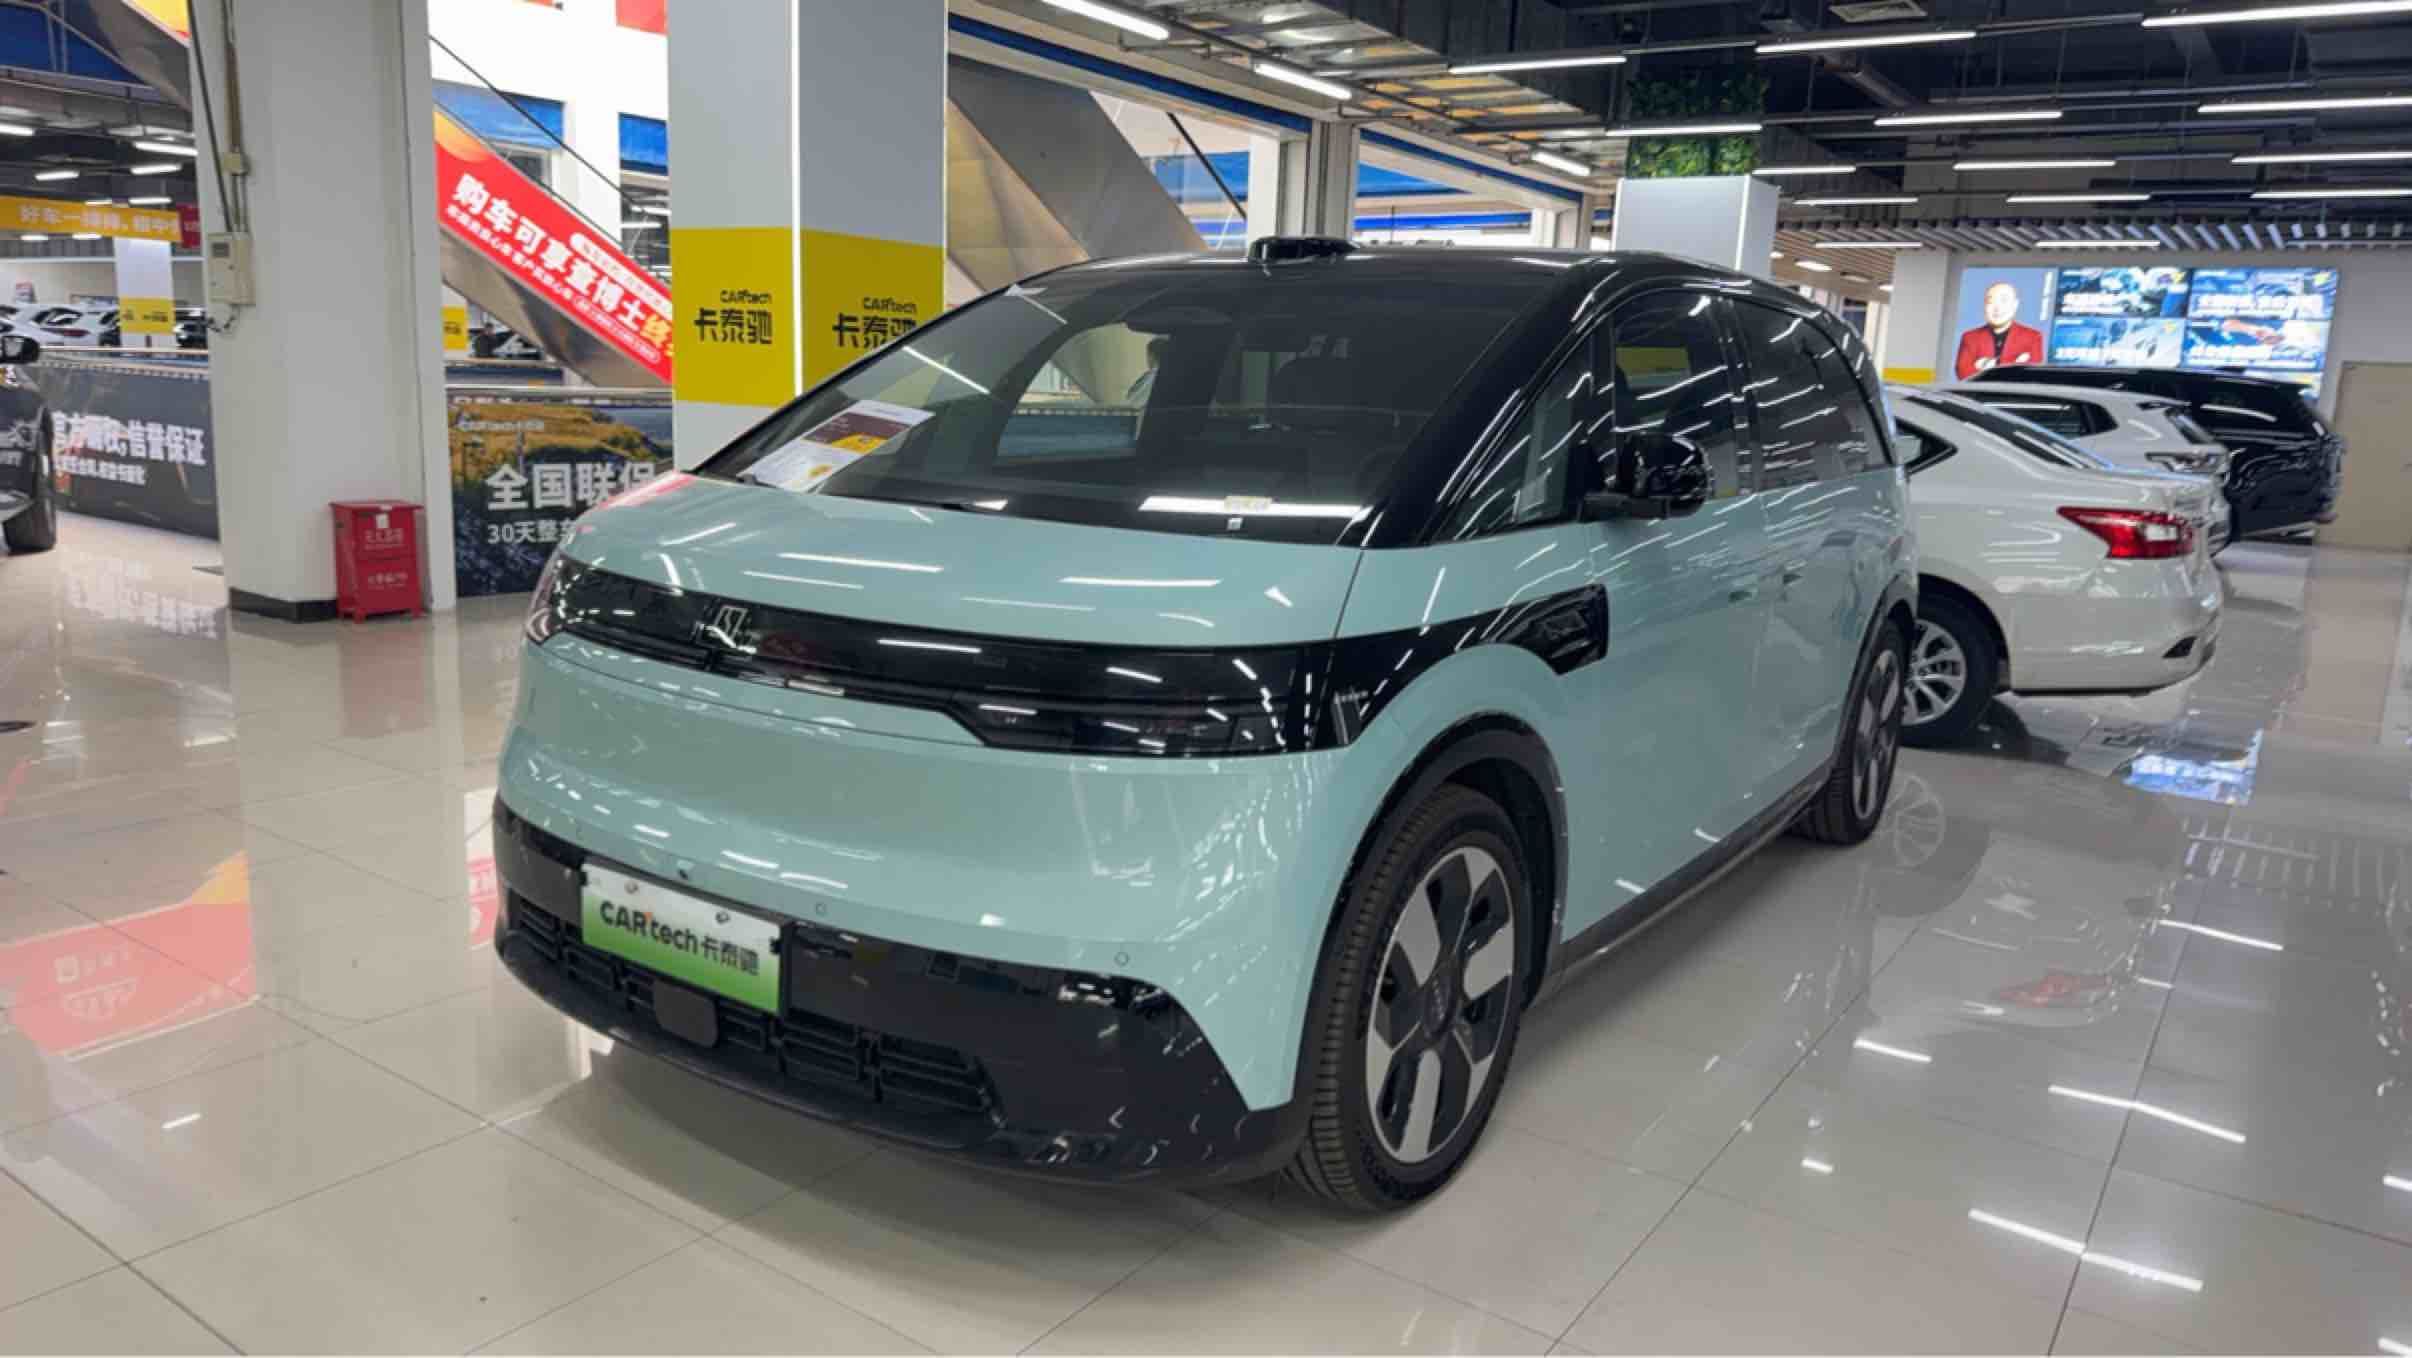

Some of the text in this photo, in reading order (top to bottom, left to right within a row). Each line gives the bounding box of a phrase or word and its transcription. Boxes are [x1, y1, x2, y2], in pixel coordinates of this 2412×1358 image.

[452, 172, 672, 357] 购车可享查博士终
[693, 307, 773, 345] 卡泰驰
